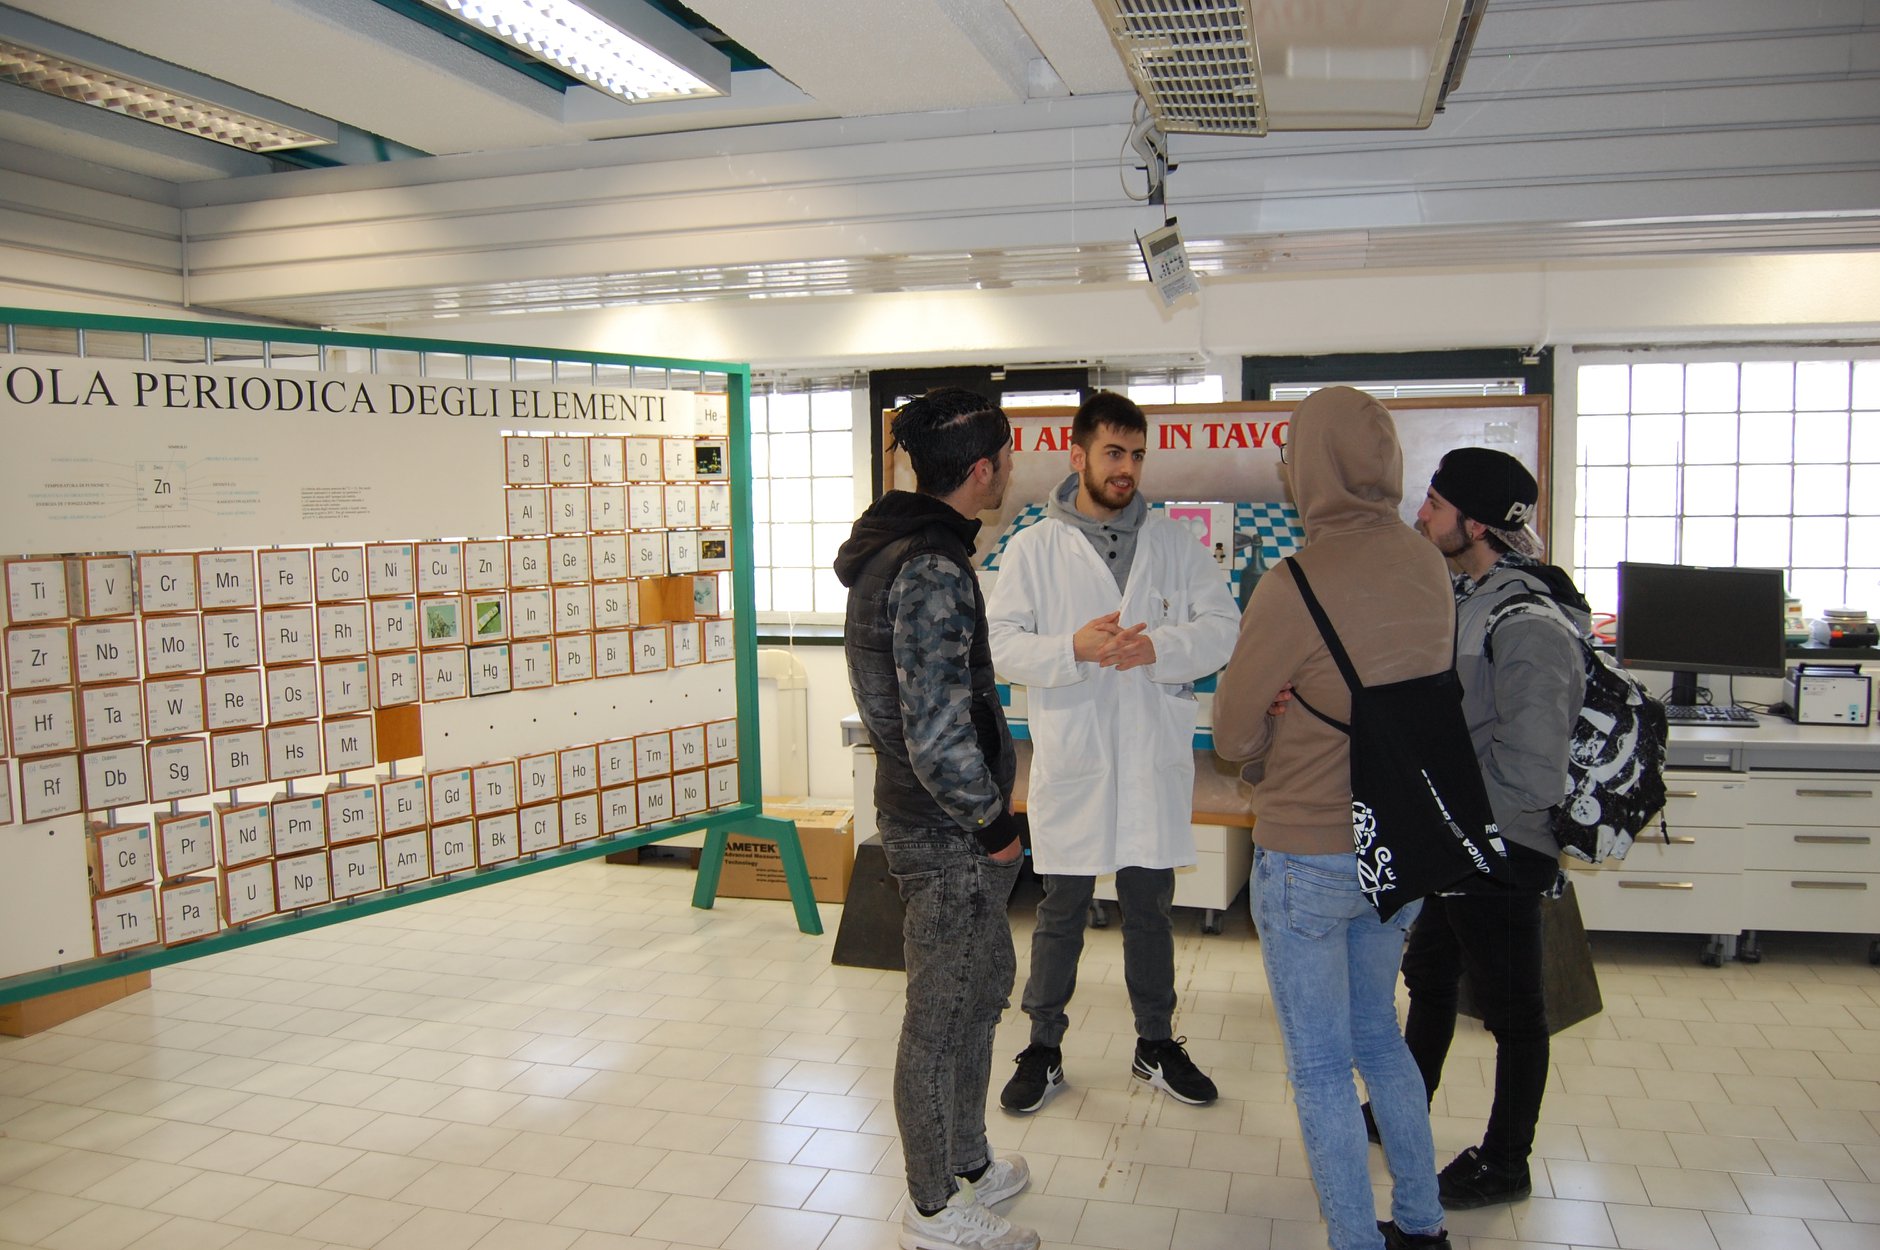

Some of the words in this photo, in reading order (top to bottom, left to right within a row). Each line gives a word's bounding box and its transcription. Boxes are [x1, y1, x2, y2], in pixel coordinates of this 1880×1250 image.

[0, 367, 118, 406] OLA
[132, 372, 377, 414] PERIODICA
[389, 383, 500, 418] DEGLI
[510, 388, 666, 423] ELEMENTI
[705, 409, 717, 421] He
[1033, 426, 1073, 451] AR
[1159, 424, 1192, 449] IN
[1202, 421, 1289, 448] TAVO
[523, 454, 529, 467] B
[564, 454, 570, 467] C
[604, 454, 610, 466] N
[640, 453, 647, 466] O
[677, 454, 681, 466] F
[154, 479, 170, 494] Zn
[523, 506, 532, 518] Al
[565, 504, 573, 517] Si
[604, 503, 610, 514] P
[643, 501, 649, 513] S
[710, 500, 719, 512] Ar
[604, 552, 615, 563] As
[641, 549, 652, 561] Se
[679, 546, 688, 559] Br
[480, 559, 492, 573] Zn
[523, 557, 536, 570] Ga
[563, 554, 576, 567] Ge
[332, 568, 348, 582] Co
[385, 563, 397, 577] Ni
[432, 561, 447, 575] Cu
[161, 575, 176, 591] Cr
[217, 573, 238, 588] Mn
[279, 570, 293, 585] Fe
[31, 583, 45, 599] Ti
[106, 579, 114, 595] V
[567, 603, 579, 616] Sn
[606, 599, 618, 612] Sb
[527, 608, 535, 620] In
[335, 624, 351, 638] Rh
[388, 617, 402, 632] Pd
[224, 633, 239, 648] Tc
[281, 629, 298, 643] Ru
[714, 635, 725, 646] Rn
[162, 637, 184, 653] Mo
[644, 645, 655, 656] Po
[682, 638, 689, 649] At
[32, 649, 47, 666] Zr
[97, 644, 118, 660] Nb
[568, 652, 580, 664] Pb
[607, 648, 615, 660] Bi
[437, 669, 452, 682] Au
[484, 664, 497, 679] Hg
[392, 673, 402, 686] Pt
[285, 687, 302, 702] Os
[343, 681, 350, 695] Ir
[168, 699, 182, 715] W
[225, 693, 243, 708] Re
[104, 707, 122, 723] Ta
[35, 714, 52, 731] Hf
[342, 737, 357, 752] Mt
[683, 743, 694, 754] Yb
[717, 737, 726, 748] Lu
[286, 744, 303, 759] Hs
[646, 750, 661, 762] Tm
[231, 752, 248, 767] Bh
[611, 757, 620, 770] Er
[170, 763, 189, 781] Sg
[573, 765, 585, 777] Ho
[105, 770, 126, 787] Db
[533, 773, 545, 787] Dy
[720, 780, 728, 791] Lr
[44, 778, 60, 796] Rf
[487, 782, 501, 796] Tb
[685, 788, 696, 799] No
[445, 789, 459, 803] Gd
[649, 794, 663, 808] Md
[398, 798, 411, 812] Eu
[613, 804, 626, 816] Fm
[343, 809, 363, 823] Sm
[575, 813, 586, 825] Es
[289, 820, 311, 834] Pm
[535, 821, 545, 834] Cf
[240, 826, 256, 844] Nd
[492, 832, 505, 846] Bk
[182, 839, 195, 854] Pr
[445, 842, 463, 855] Cm
[725, 842, 775, 853] AMETEK
[119, 851, 136, 867] Ce
[398, 853, 417, 867] Am
[349, 863, 364, 877] Pu
[295, 875, 313, 891] Np
[248, 885, 256, 900] U
[183, 905, 200, 920] Pa
[117, 913, 137, 929] Th
